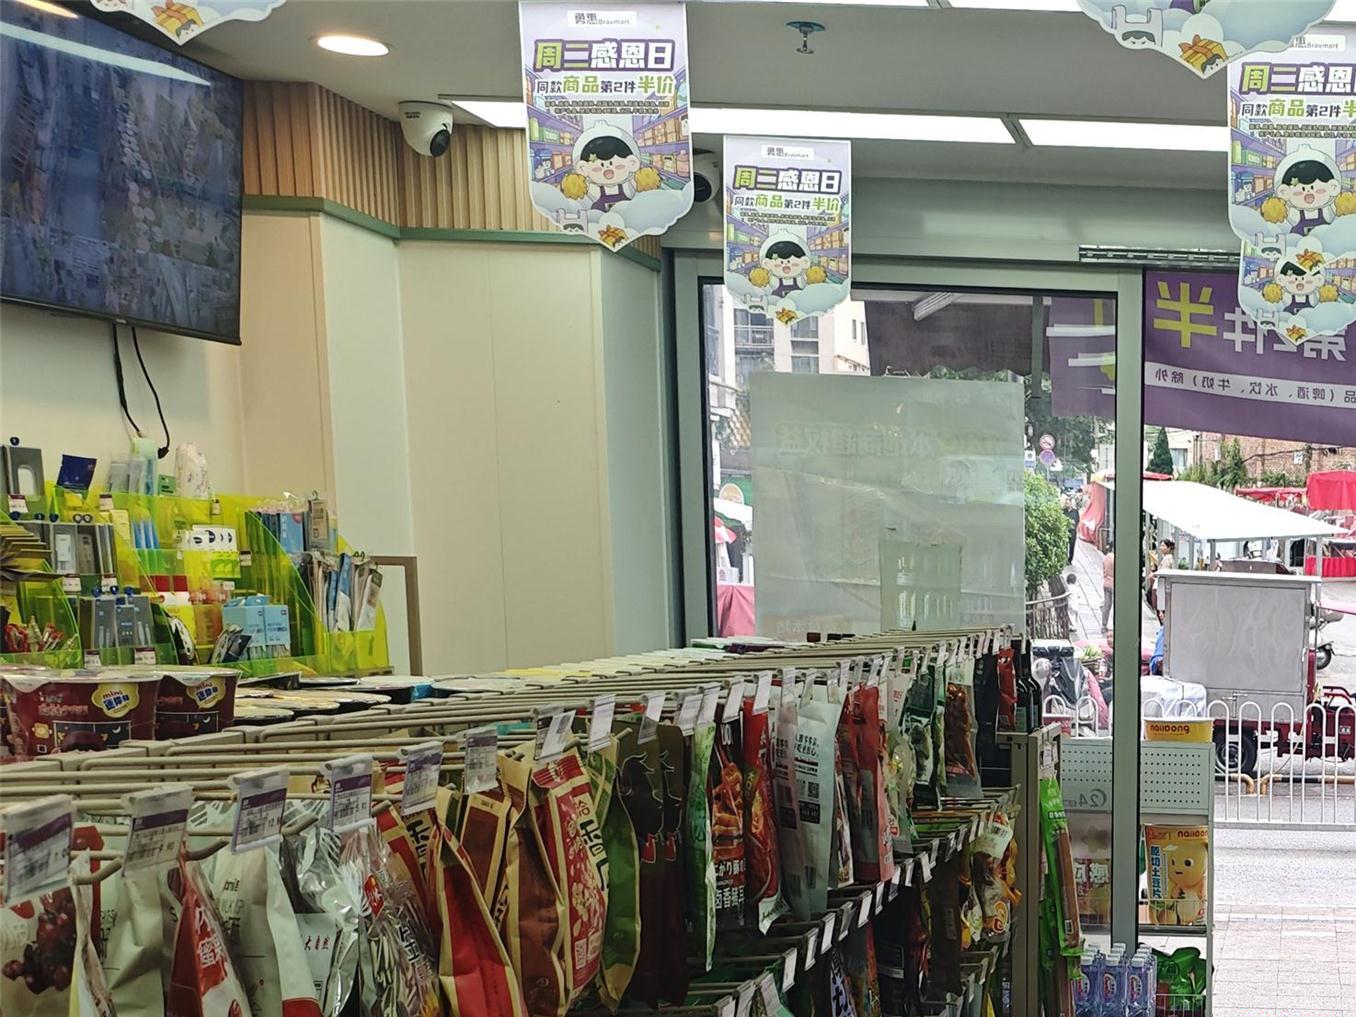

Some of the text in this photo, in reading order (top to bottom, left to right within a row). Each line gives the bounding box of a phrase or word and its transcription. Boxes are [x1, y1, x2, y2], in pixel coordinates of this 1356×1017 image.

[535, 39, 675, 72] 周二感恩日
[537, 75, 675, 94] 同款商品第2件半价
[733, 165, 842, 195] 周二感恩日
